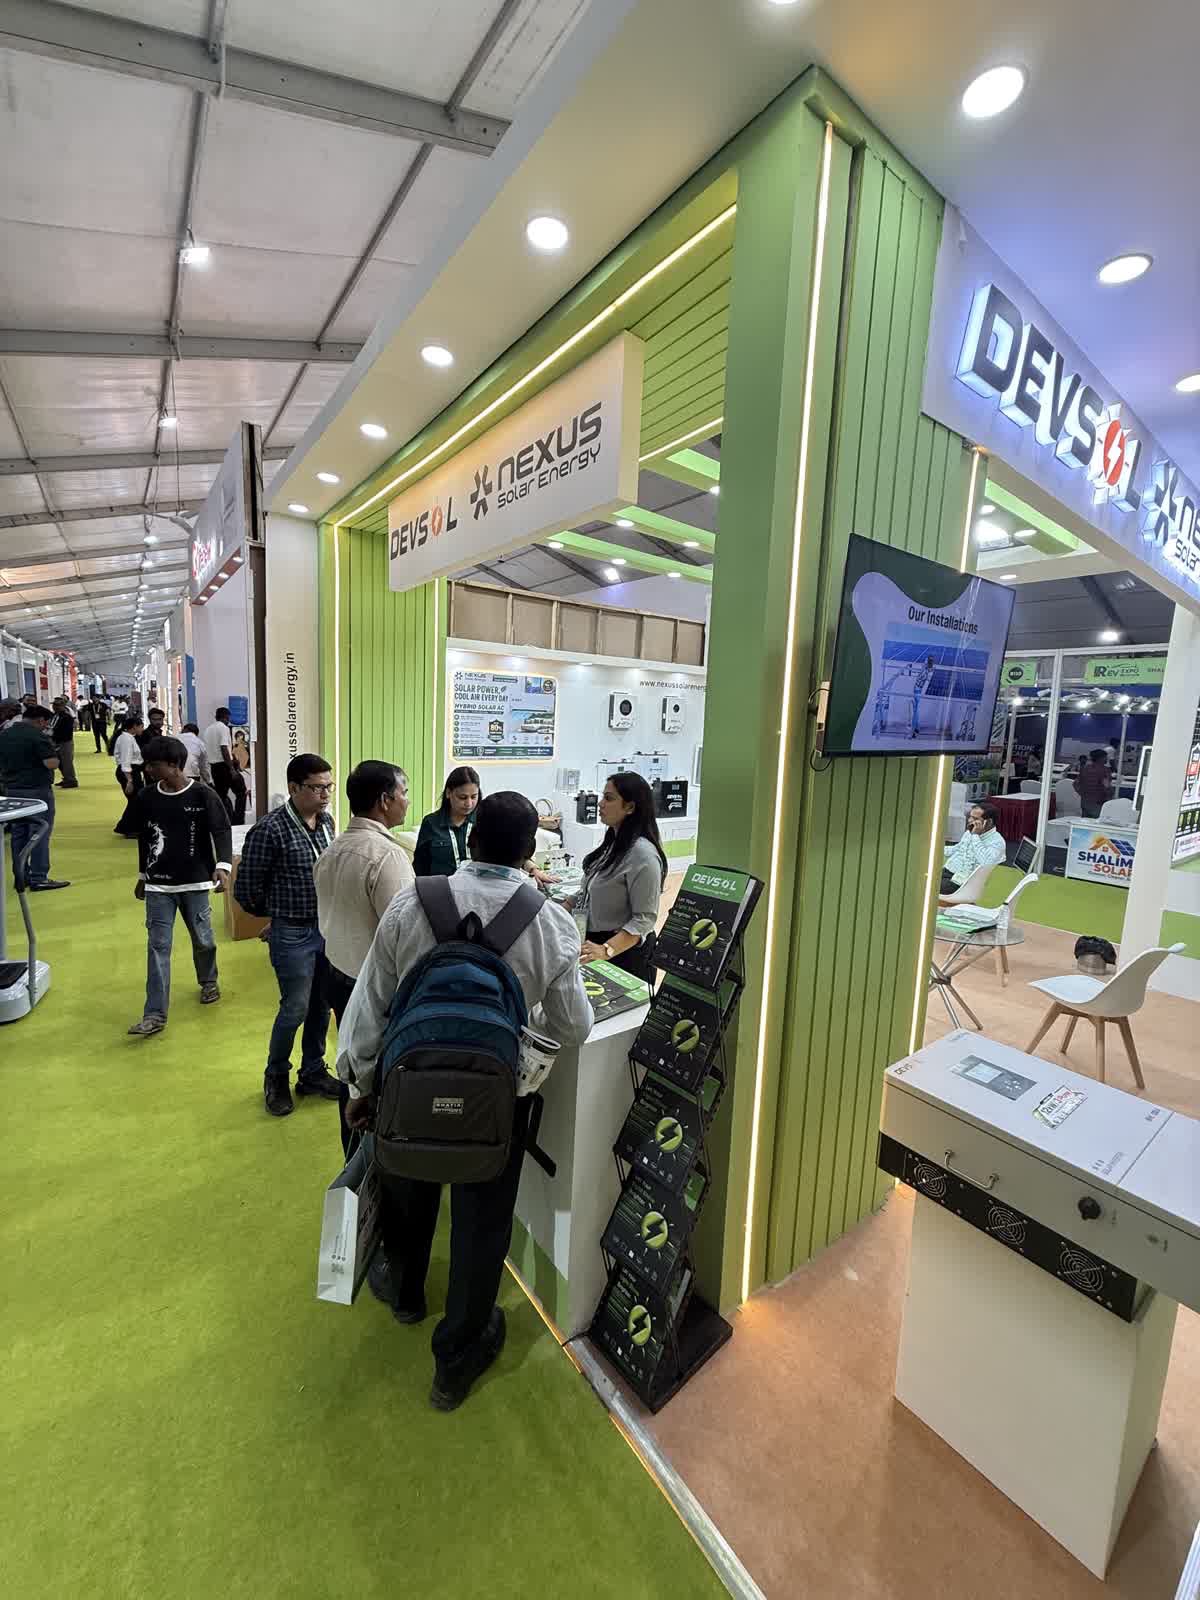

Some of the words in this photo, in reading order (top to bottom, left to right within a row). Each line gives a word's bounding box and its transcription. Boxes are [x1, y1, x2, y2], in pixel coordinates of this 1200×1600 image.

[963, 283, 1141, 512] DEVSOL
[390, 496, 458, 561] DEVSOL
[908, 606, 924, 622] Our
[926, 609, 979, 635] Installations
[454, 683, 476, 692] SOLAR
[454, 692, 470, 701] COOL
[470, 693, 481, 701] AIR
[481, 693, 499, 702] EVERY
[498, 694, 509, 702] DAY
[284, 652, 298, 760] xussolarenergy.in
[691, 873, 737, 891] DEVSOL
